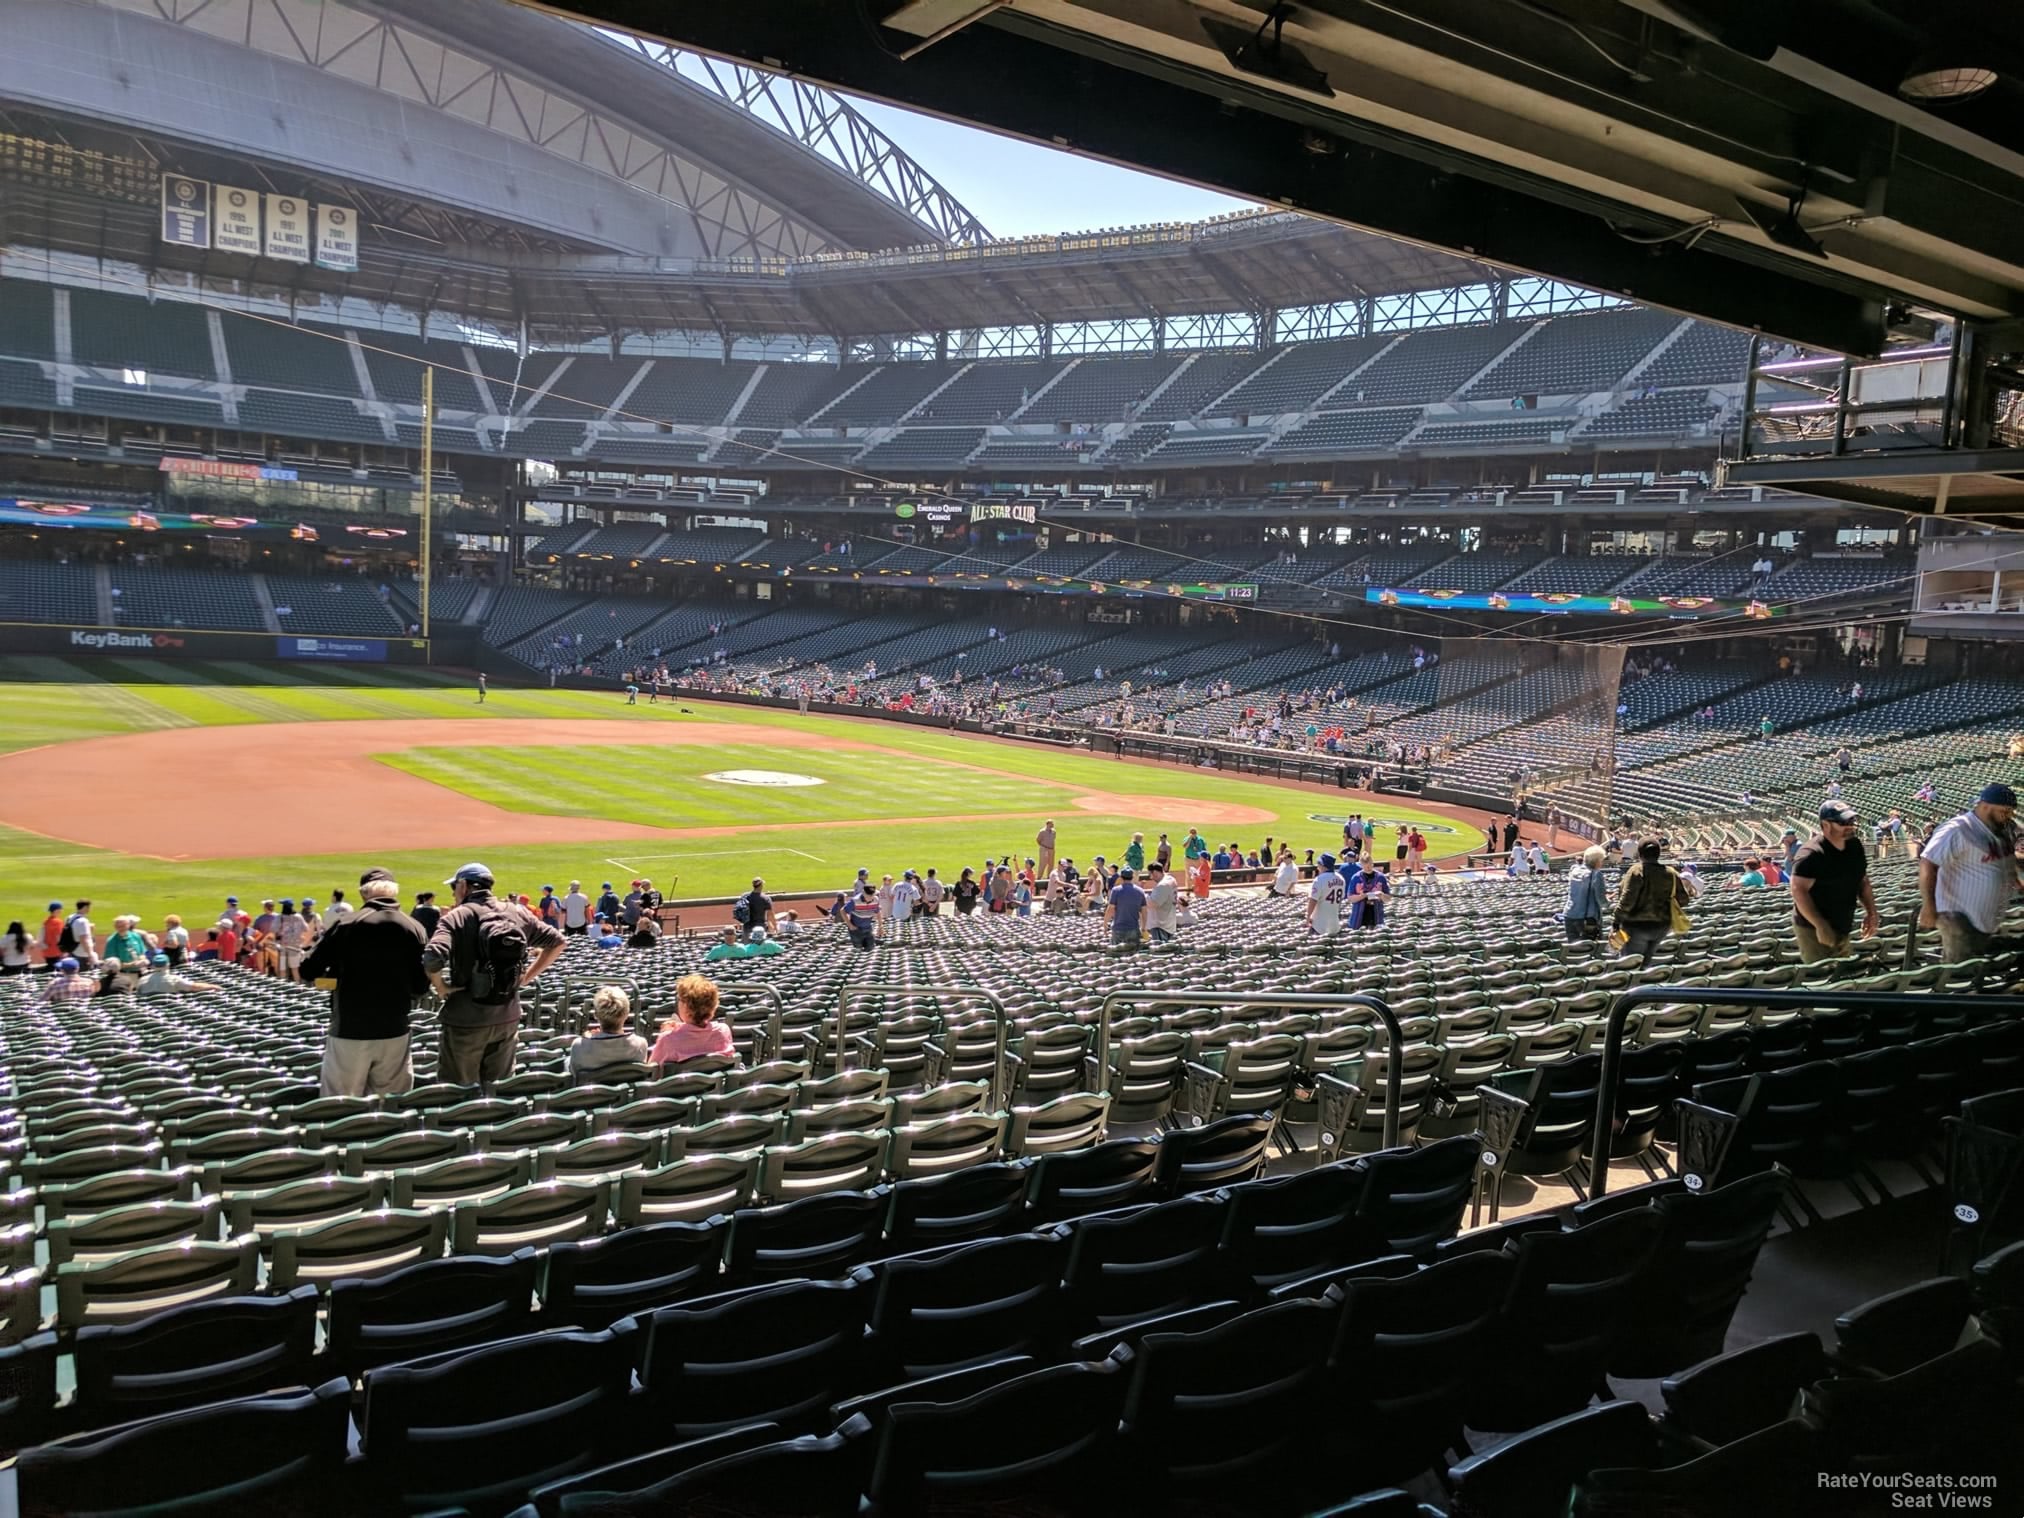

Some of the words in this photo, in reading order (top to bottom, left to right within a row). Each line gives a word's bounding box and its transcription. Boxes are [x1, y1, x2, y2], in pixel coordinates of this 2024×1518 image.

[235, 225, 254, 236] WEST
[218, 235, 258, 250] CHAMPIONS
[285, 233, 303, 244] WEST
[269, 243, 307, 258] CHAMPIONS
[334, 241, 352, 251] WEST
[319, 251, 355, 265] CHAMPIONS
[1012, 505, 1036, 524] CLUB
[1230, 587, 1252, 598] 11:23
[71, 631, 153, 648] KeyBank
[1325, 888, 1343, 904] 48
